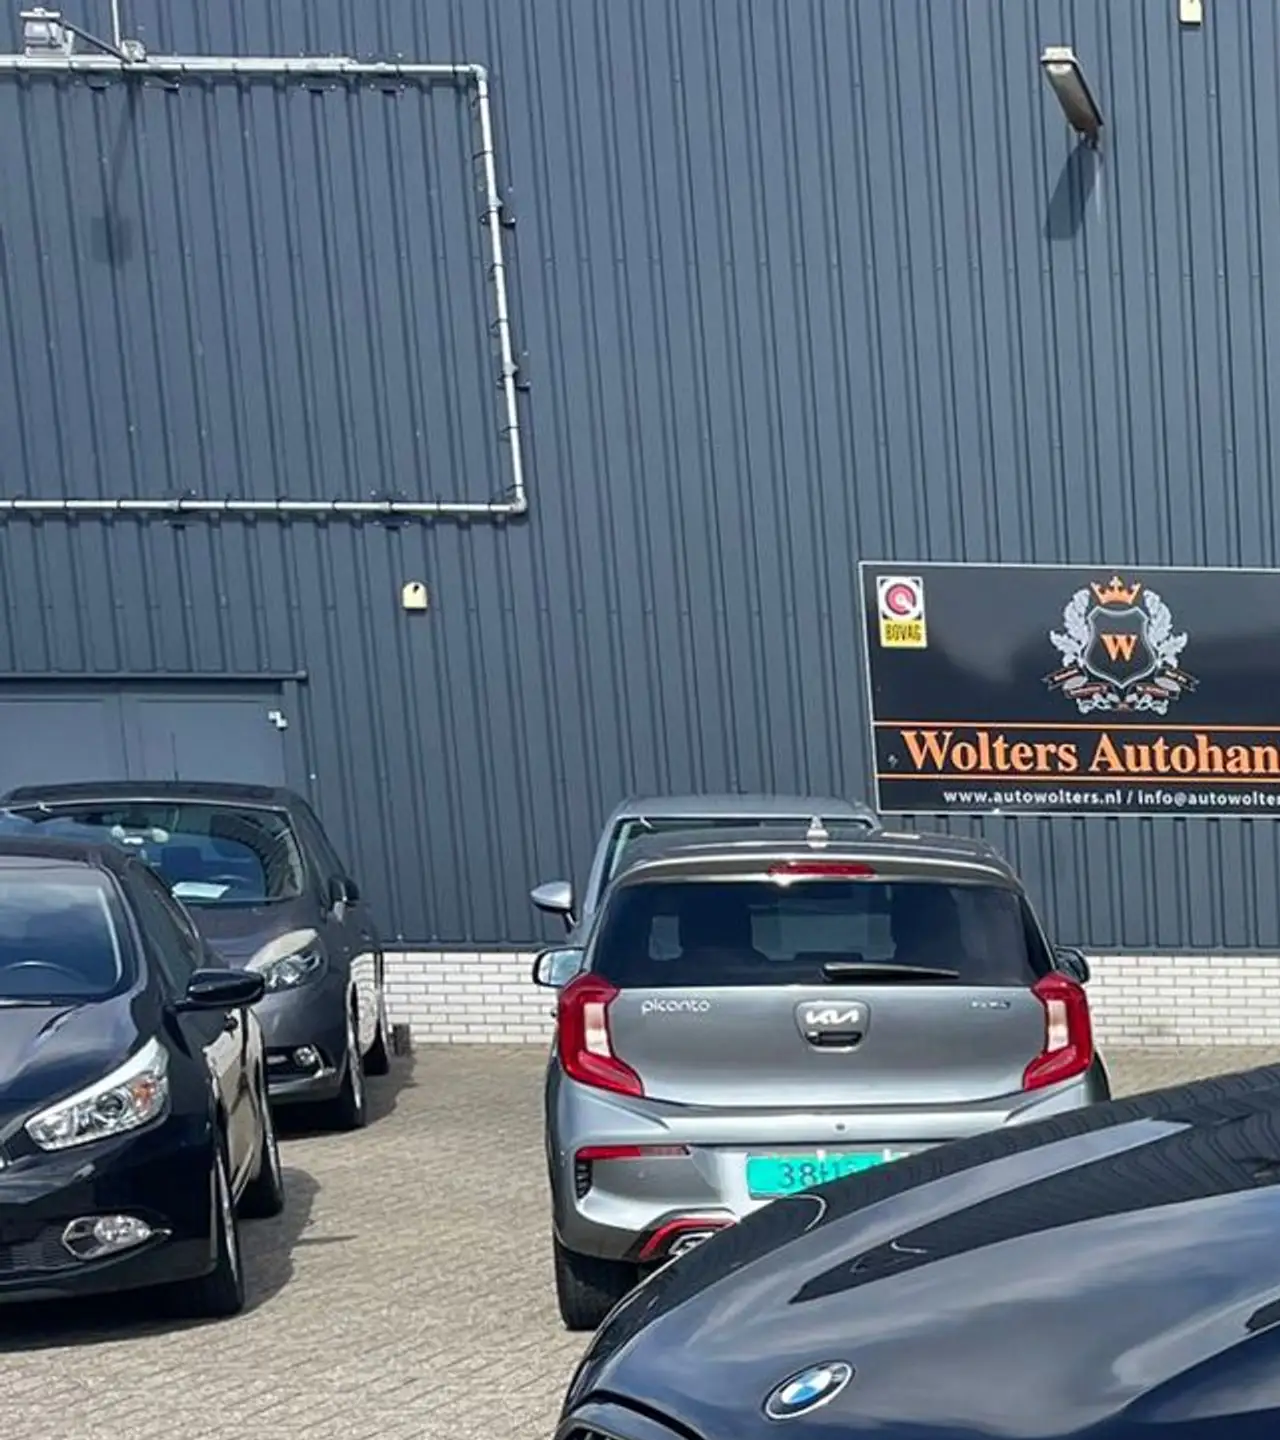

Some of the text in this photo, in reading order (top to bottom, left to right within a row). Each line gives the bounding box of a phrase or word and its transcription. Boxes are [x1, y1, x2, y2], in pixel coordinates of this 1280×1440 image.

[885, 624, 922, 641] BOVAG
[1100, 633, 1138, 662] W
[901, 730, 1079, 773] Wolters
[943, 787, 1122, 806] www.autowolters.nl
